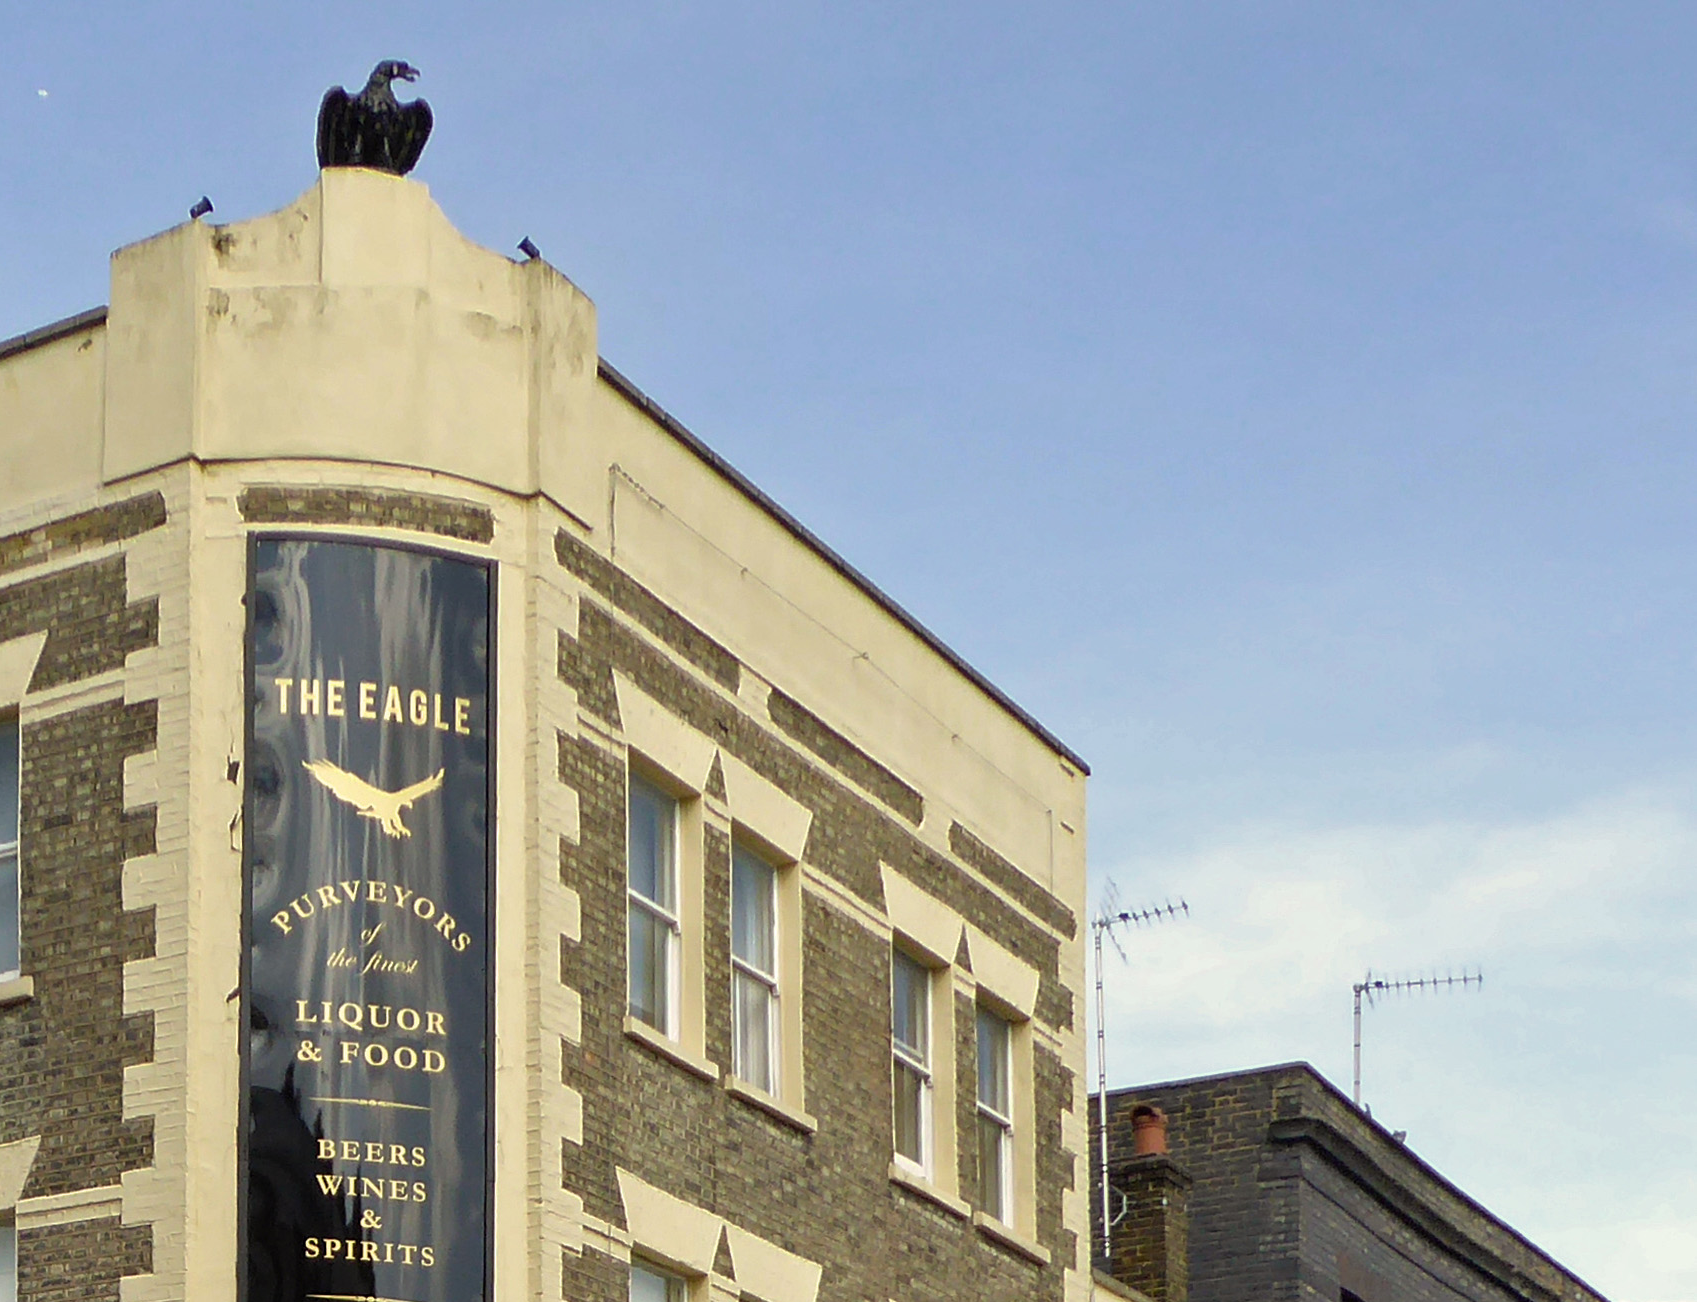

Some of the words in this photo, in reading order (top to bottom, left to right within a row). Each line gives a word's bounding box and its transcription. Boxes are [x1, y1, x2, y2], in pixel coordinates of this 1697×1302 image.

[275, 677, 345, 717] THE
[359, 682, 471, 735] EAGLE
[270, 879, 472, 953] PURVEYORS
[360, 921, 386, 946] of
[325, 948, 357, 969] the
[361, 951, 419, 976] finest
[295, 1000, 447, 1035] LIQUOR
[297, 1039, 322, 1062] &
[340, 1041, 446, 1074] FOOD
[317, 1138, 426, 1167] BEERS
[315, 1173, 427, 1202] WINES
[360, 1208, 382, 1229] &
[305, 1237, 435, 1267] SPIRITS
